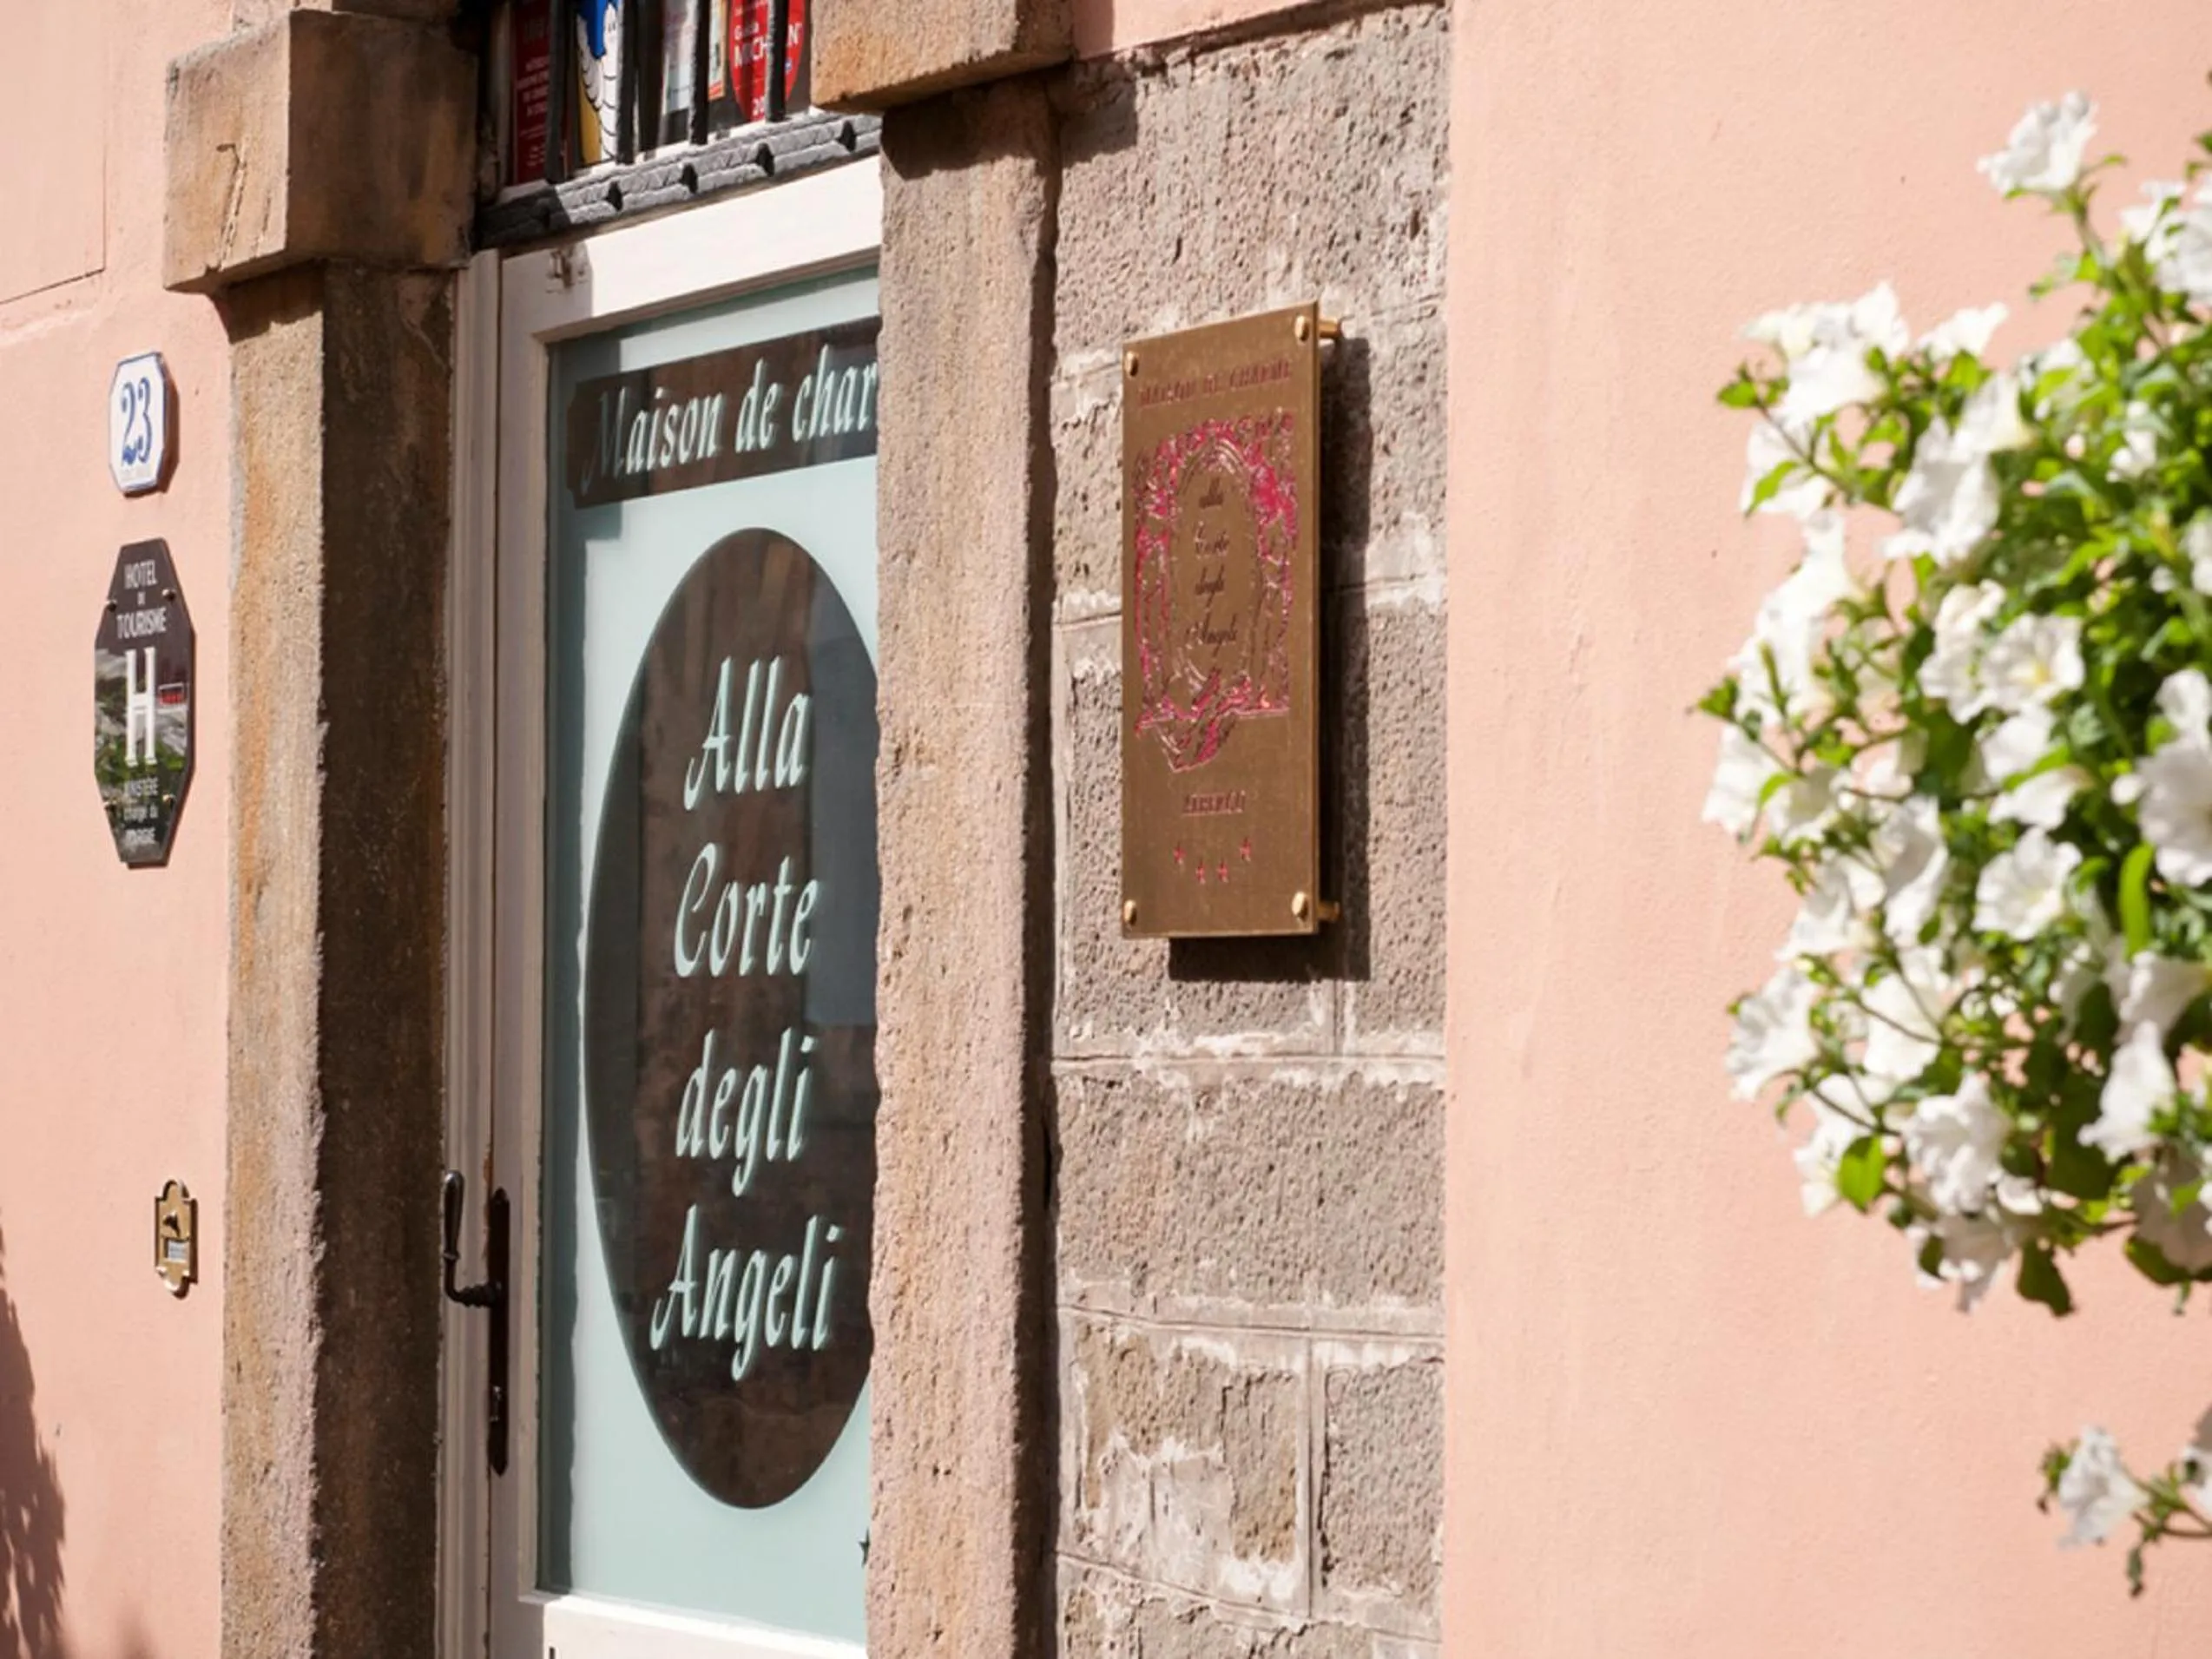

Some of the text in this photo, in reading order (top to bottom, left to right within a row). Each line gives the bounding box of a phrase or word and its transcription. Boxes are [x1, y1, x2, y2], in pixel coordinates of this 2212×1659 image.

[121, 376, 152, 466] 23
[581, 344, 878, 497] Maison de char
[117, 607, 167, 639] TOURISME
[683, 655, 808, 811] Alla
[675, 843, 819, 978] Corte
[675, 1027, 816, 1197] degli
[649, 1203, 841, 1381] Angeli
